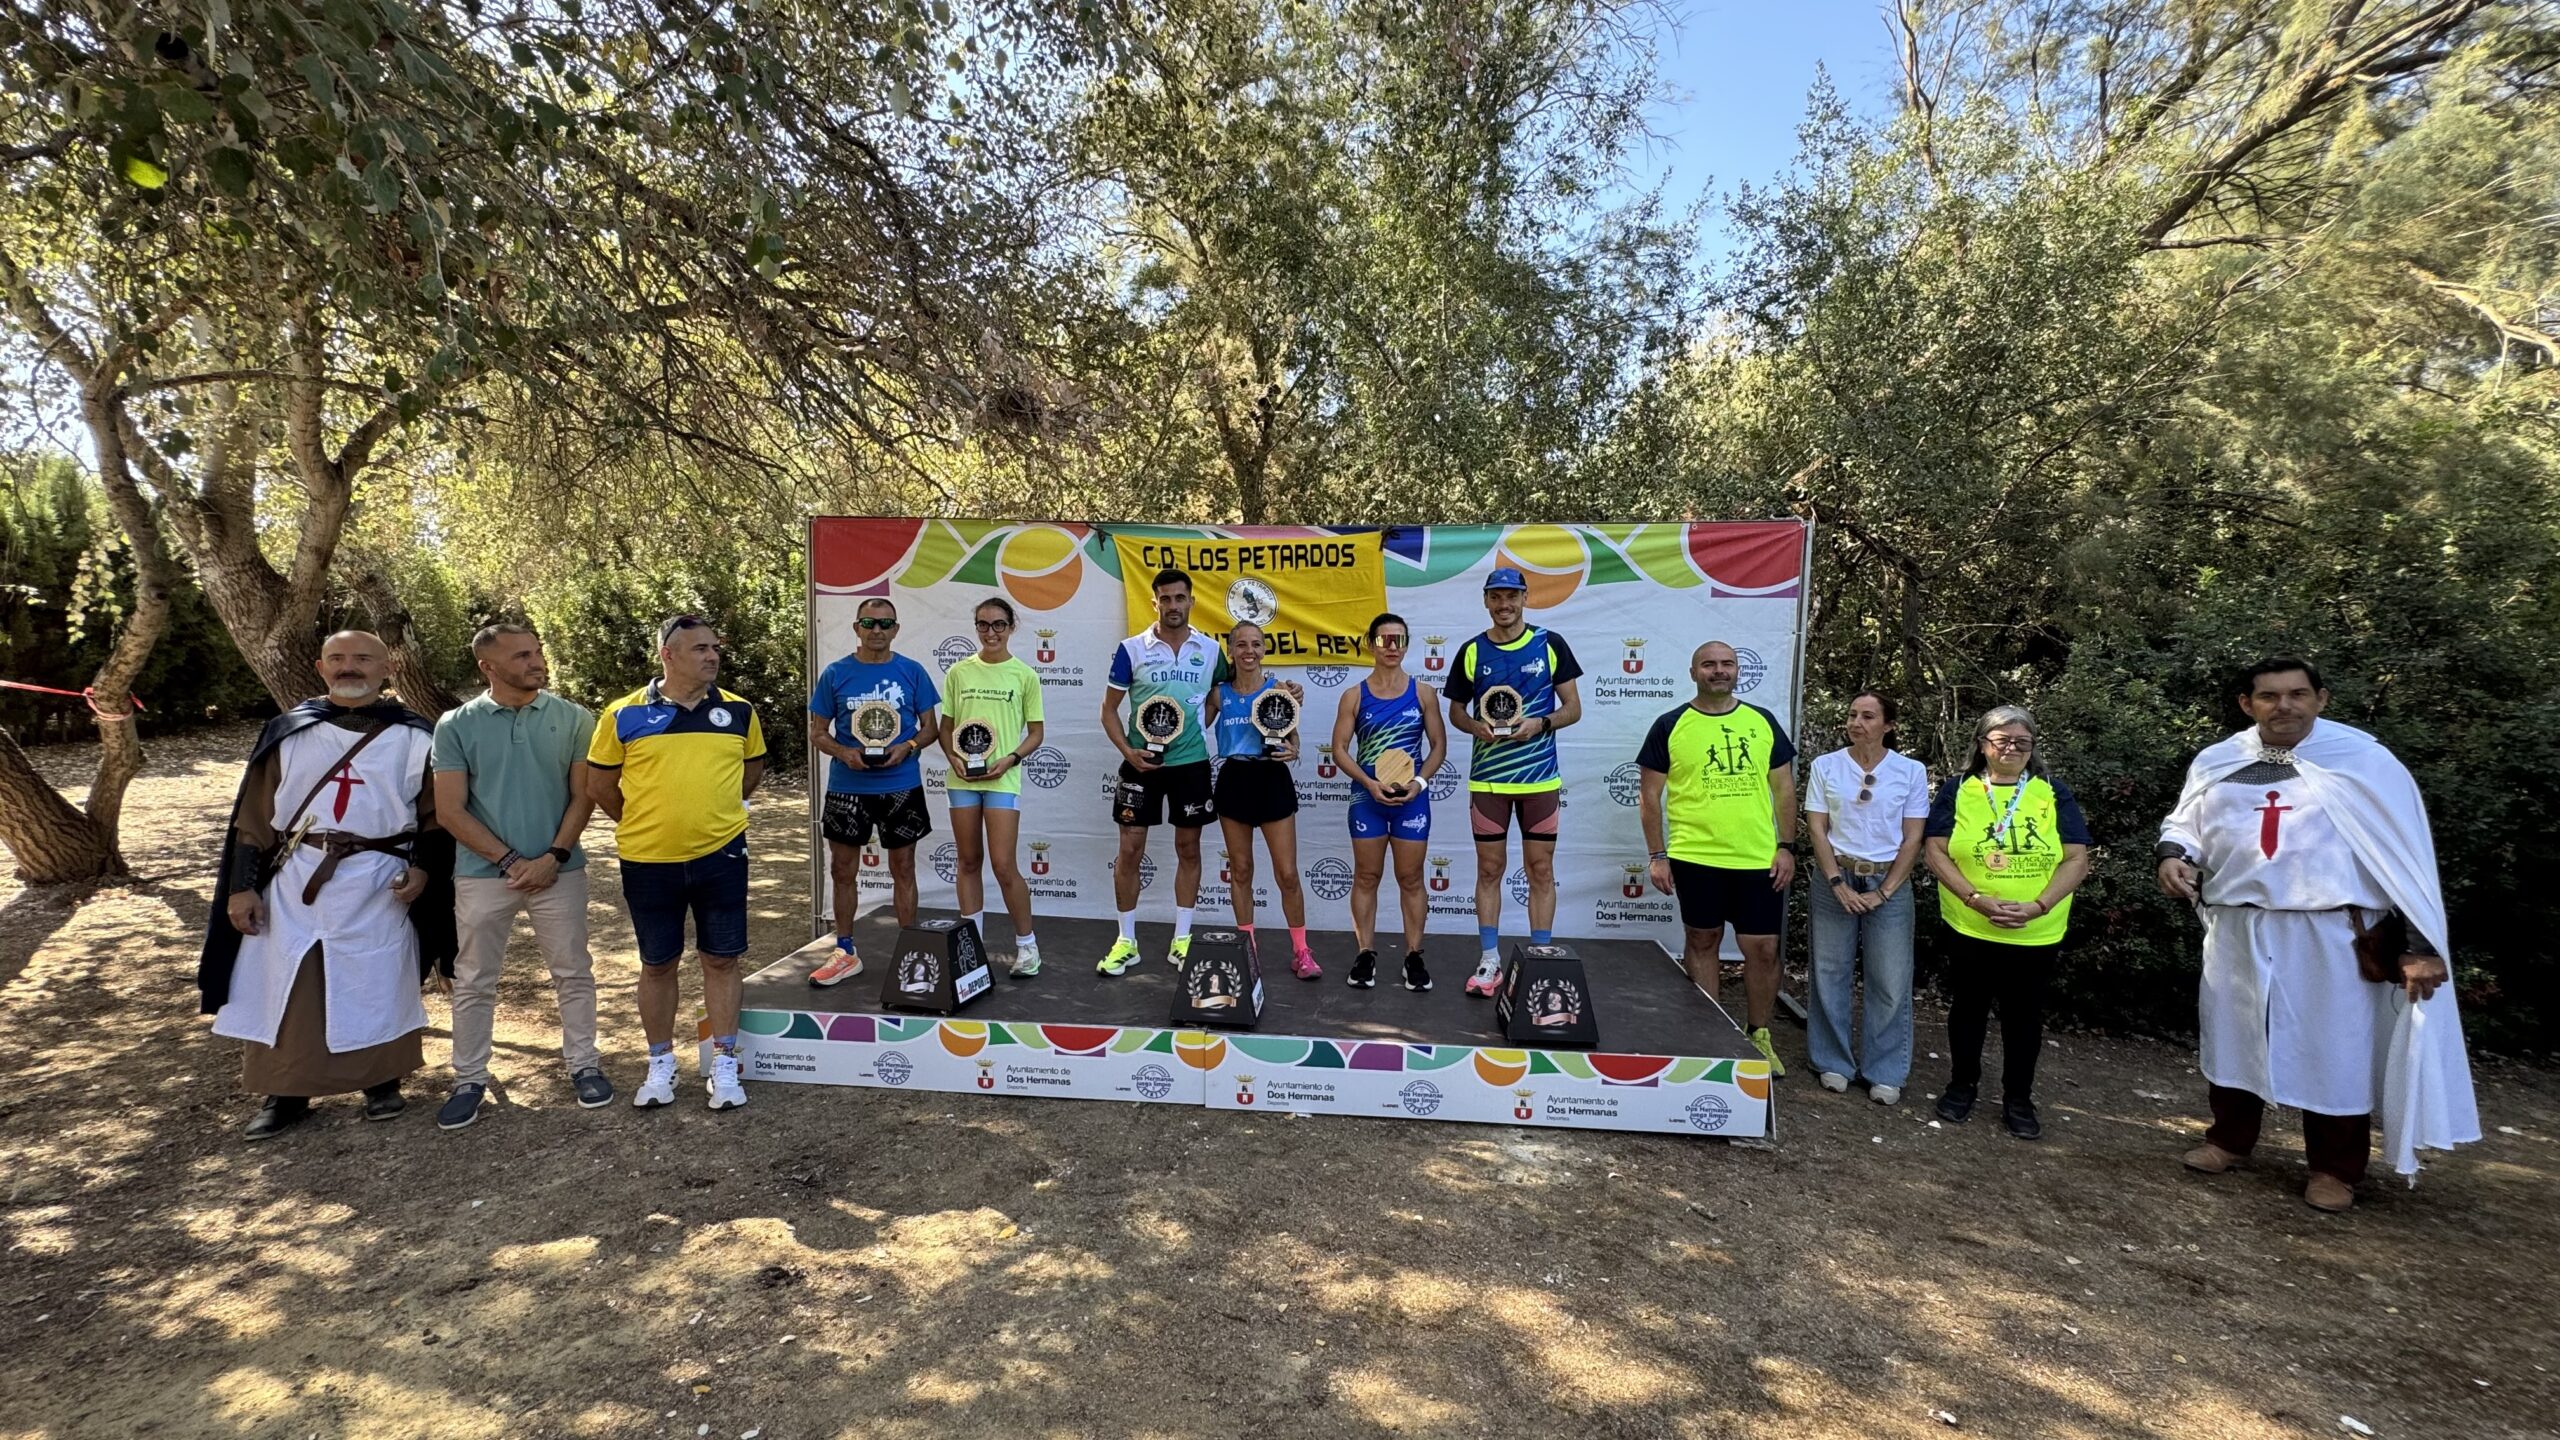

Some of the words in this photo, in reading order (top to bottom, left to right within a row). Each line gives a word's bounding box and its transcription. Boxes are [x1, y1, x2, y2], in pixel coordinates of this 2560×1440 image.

[1142, 545, 1179, 569] C.D.
[1187, 544, 1230, 571] LOS
[1238, 543, 1356, 574] PETARDOS
[1317, 634, 1362, 657] REY
[1072, 666, 1084, 675] de
[1263, 671, 1275, 679] de
[1739, 671, 1764, 679] limpio
[1595, 676, 1660, 686] Ayuntamiento
[1661, 676, 1675, 686] de
[1595, 688, 1617, 698] Dos
[1619, 688, 1674, 699] Hermanas
[1036, 760, 1071, 768] Hermanas
[1047, 767, 1068, 775] limpio
[926, 779, 946, 788] Dos
[1435, 779, 1458, 787] limpio
[1603, 776, 1619, 784] Dos
[1102, 785, 1116, 793] Do
[1066, 878, 1078, 887] de
[1331, 878, 1353, 886] limpio
[1030, 887, 1078, 898] Hermanas
[1256, 886, 1268, 896] de
[1196, 895, 1216, 905] Dos
[1596, 899, 1659, 911] Ayuntamiento
[1660, 901, 1674, 911] de
[1427, 905, 1477, 916] Hermanas
[1596, 911, 1617, 921] Dos
[1618, 911, 1673, 923] Hermanas
[914, 963, 926, 981] 2
[1209, 974, 1220, 994] 1
[1547, 992, 1562, 1011] 3
[754, 1051, 805, 1062] Ayuntamiento
[805, 1053, 816, 1062] de
[755, 1060, 772, 1070] Dos
[773, 1062, 817, 1072] Hermanas
[1006, 1064, 1060, 1076] Ayuntamiento
[1060, 1067, 1072, 1075] de
[1006, 1074, 1025, 1084] Dos
[1026, 1076, 1072, 1086] Hermanas
[1267, 1080, 1324, 1092] Ayuntamiento
[1324, 1082, 1336, 1091] de
[1267, 1090, 1286, 1100] Dos
[1287, 1091, 1335, 1102] Hermanas
[1546, 1094, 1606, 1106] Ayuntamiento
[1606, 1098, 1619, 1106] de
[1546, 1105, 1566, 1115] Dos
[1567, 1106, 1618, 1117] Hermanas
